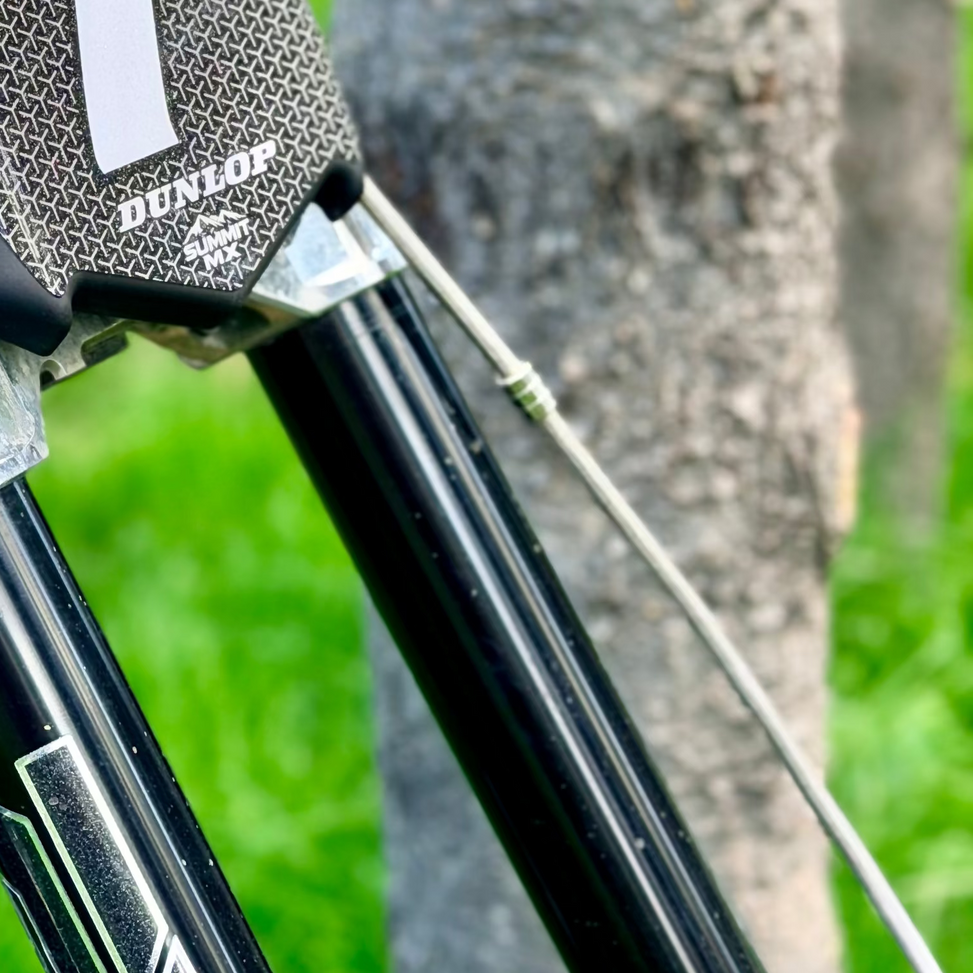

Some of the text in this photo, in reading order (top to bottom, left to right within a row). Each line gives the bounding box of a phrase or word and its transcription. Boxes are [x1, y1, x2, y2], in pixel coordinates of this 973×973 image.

[117, 139, 276, 233] DUNLOP
[183, 218, 250, 262] SUMMIT
[202, 241, 241, 270] MX
